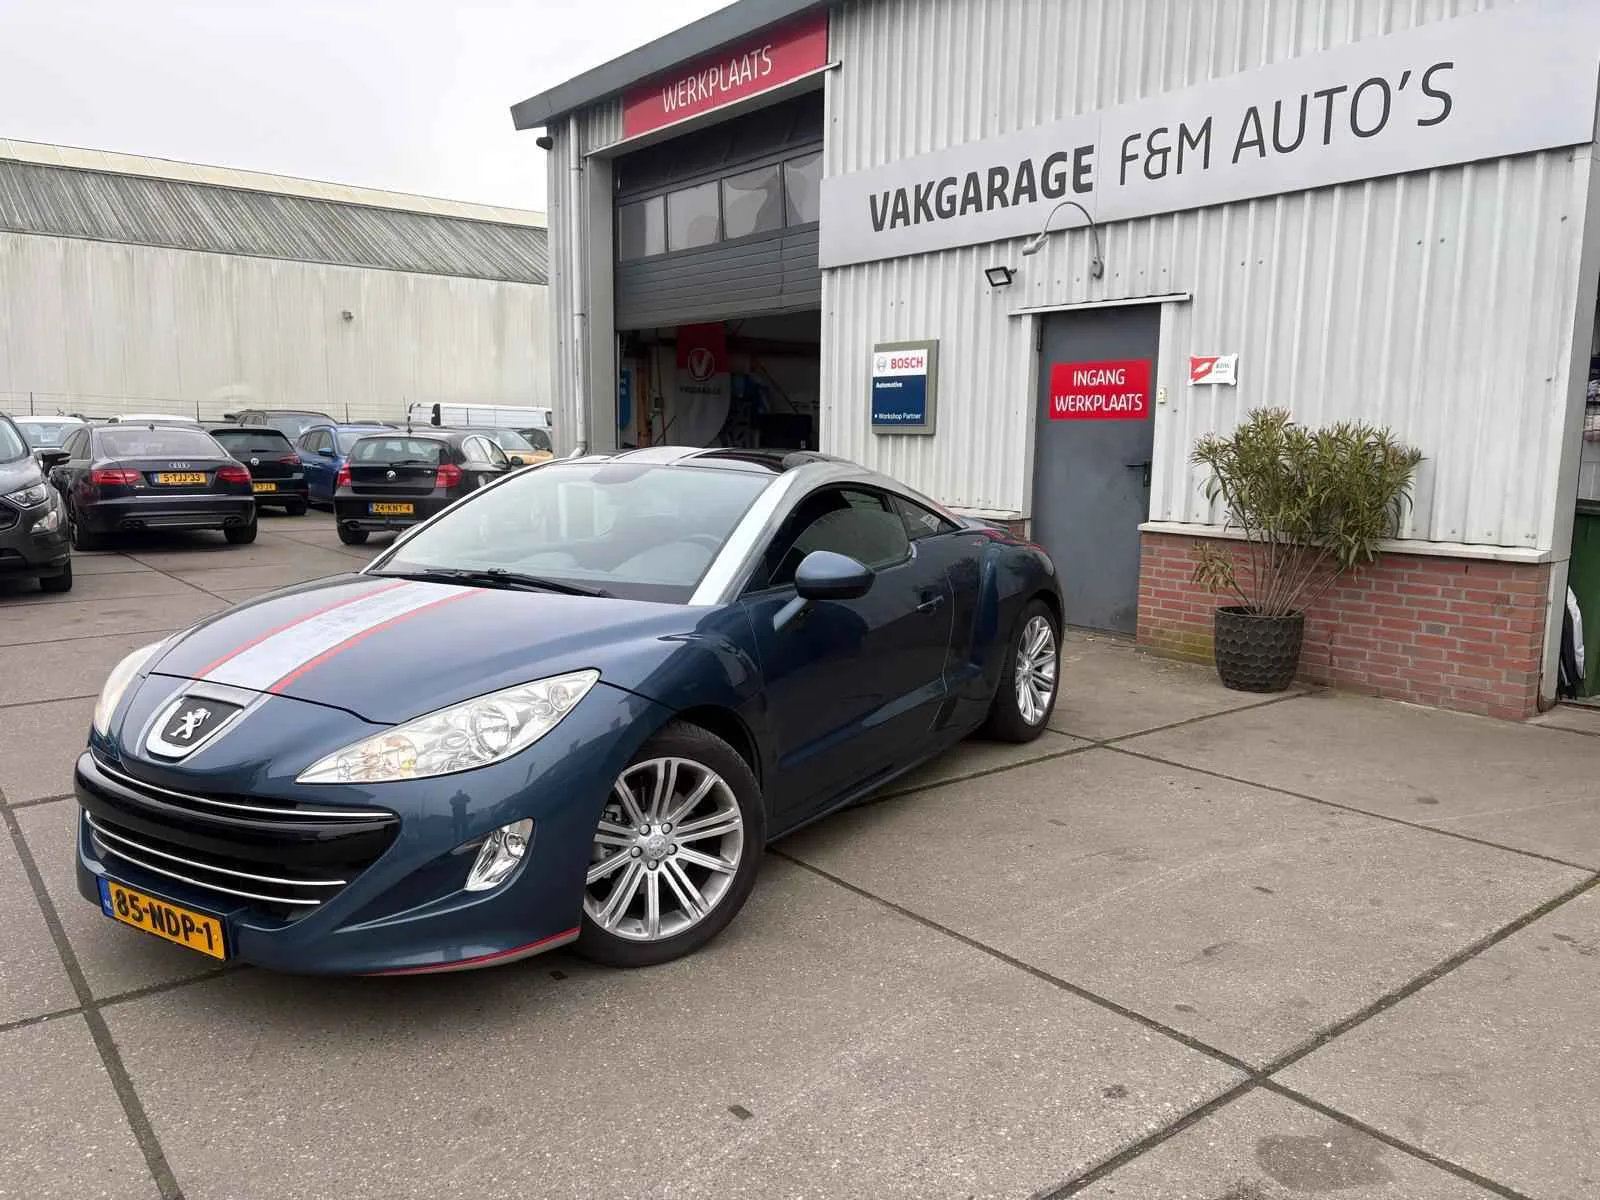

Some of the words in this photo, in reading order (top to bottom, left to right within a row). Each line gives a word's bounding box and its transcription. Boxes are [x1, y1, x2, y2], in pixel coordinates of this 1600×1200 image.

[662, 44, 772, 113] WERKPLAATS
[869, 144, 1095, 232] VAKGARAGE
[1119, 117, 1213, 186] F&M
[1232, 62, 1454, 164] AUTO'S
[891, 357, 923, 369] BOSCH
[1073, 368, 1126, 387] INGANG
[1055, 393, 1143, 412] WERKPLAATS
[115, 888, 214, 951] 85-NDP-1
